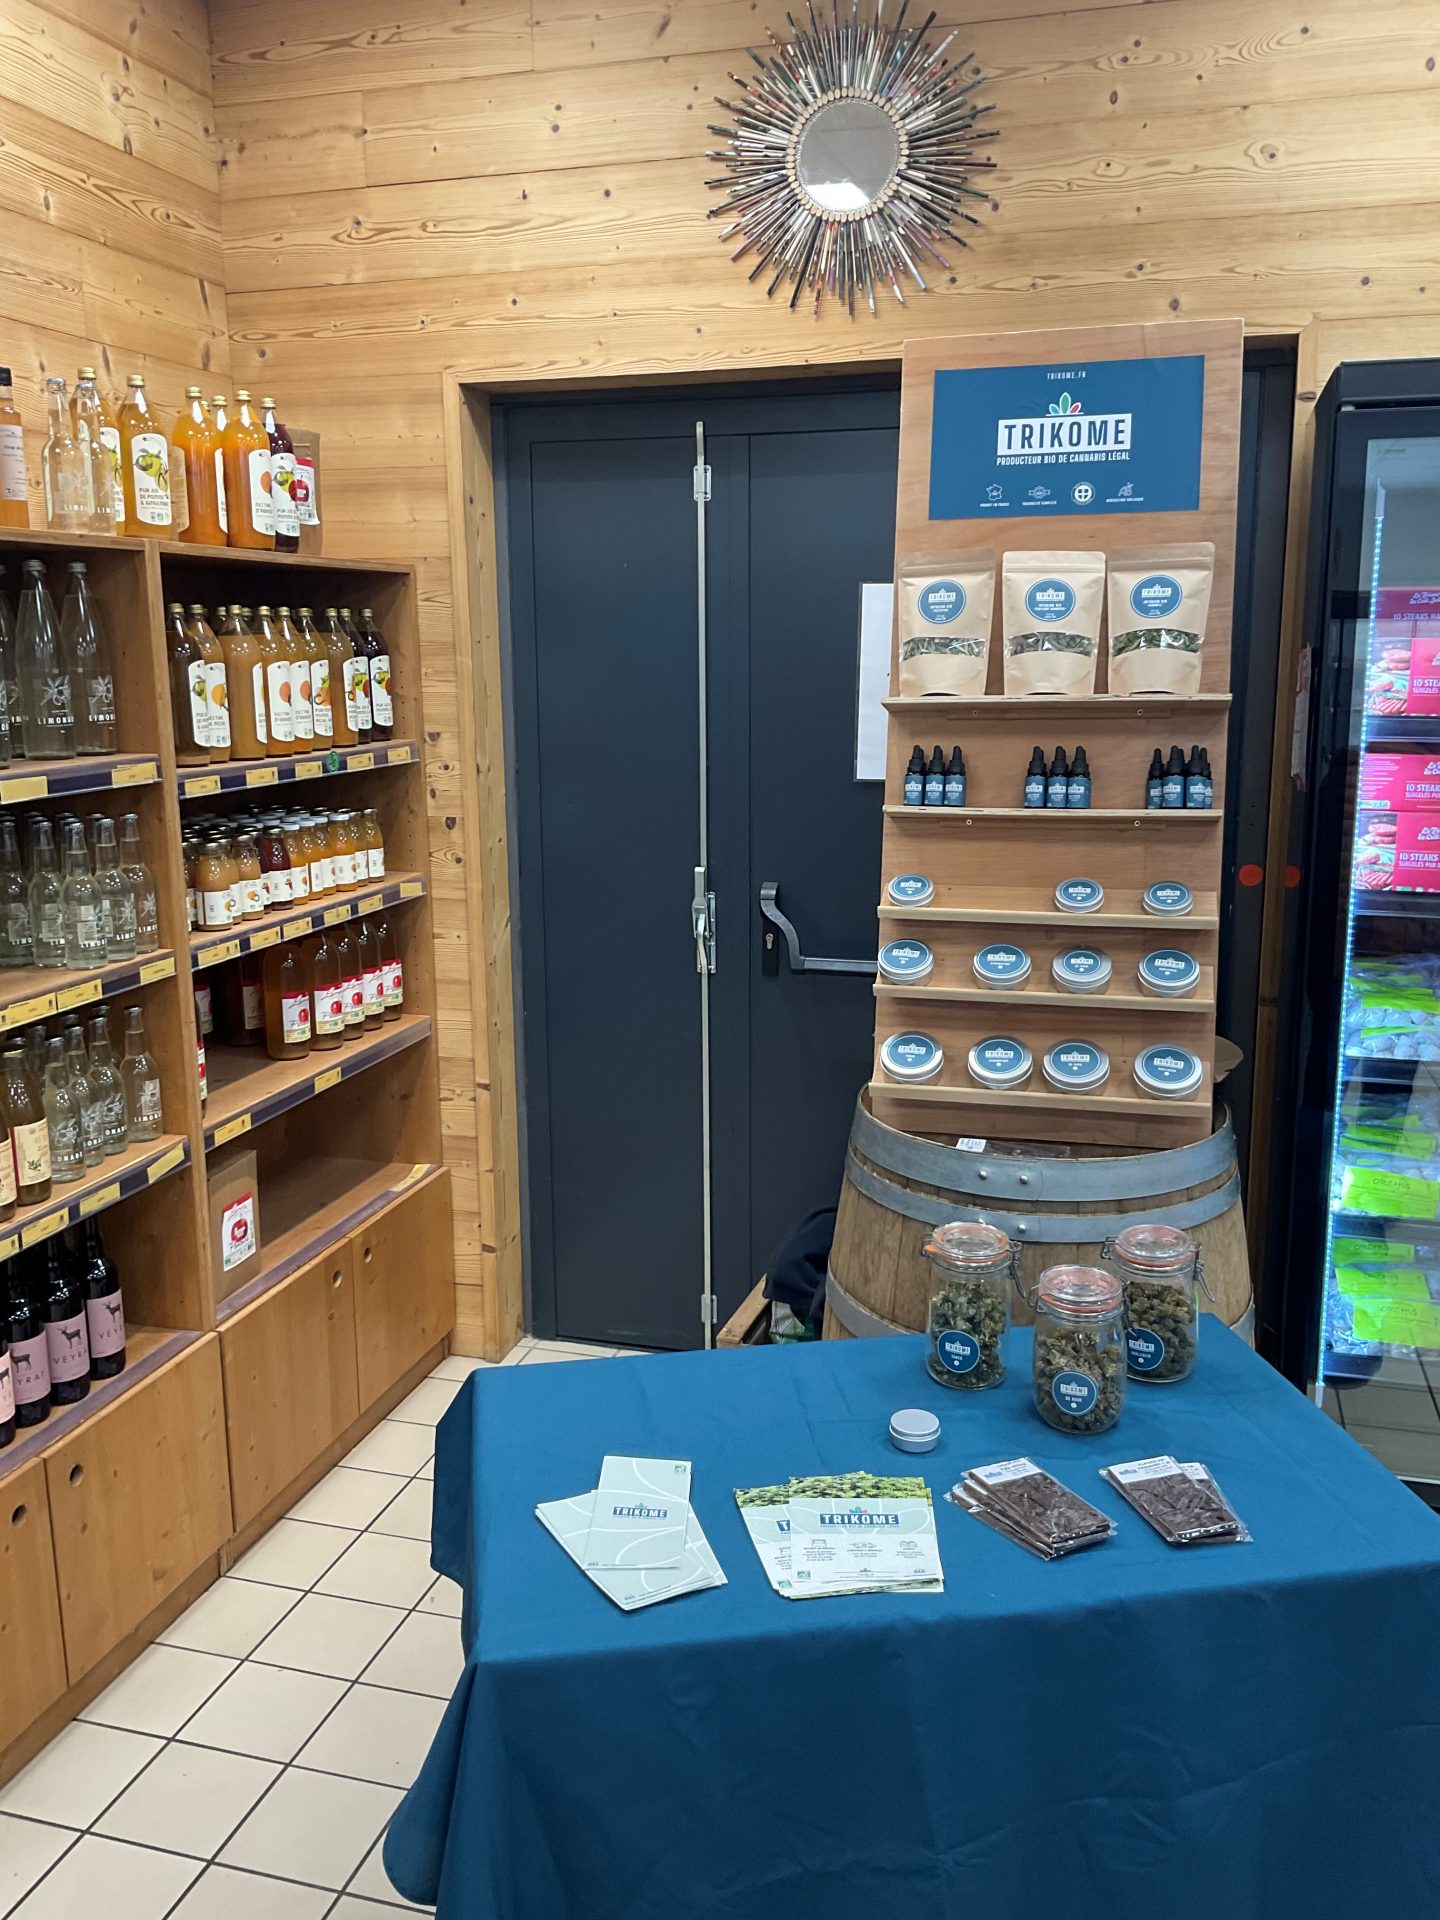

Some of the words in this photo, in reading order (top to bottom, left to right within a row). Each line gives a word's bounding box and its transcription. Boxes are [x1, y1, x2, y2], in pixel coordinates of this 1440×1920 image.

[1046, 370, 1087, 380] TRIKOME.FR
[1004, 419, 1126, 450] TRIKOME
[996, 456, 1042, 466] PRODUCTEUR
[1043, 454, 1056, 464] BIO
[1058, 453, 1068, 463] DE
[1069, 452, 1106, 463] CANNABIS
[1108, 451, 1131, 461] LÉGAL
[1413, 679, 1423, 687] 10
[1406, 783, 1415, 791] 10
[1399, 852, 1408, 861] 10
[1410, 852, 1439, 861] STEAKS
[615, 1507, 667, 1518] TRIKOME
[822, 1514, 897, 1524] TRIKOME
